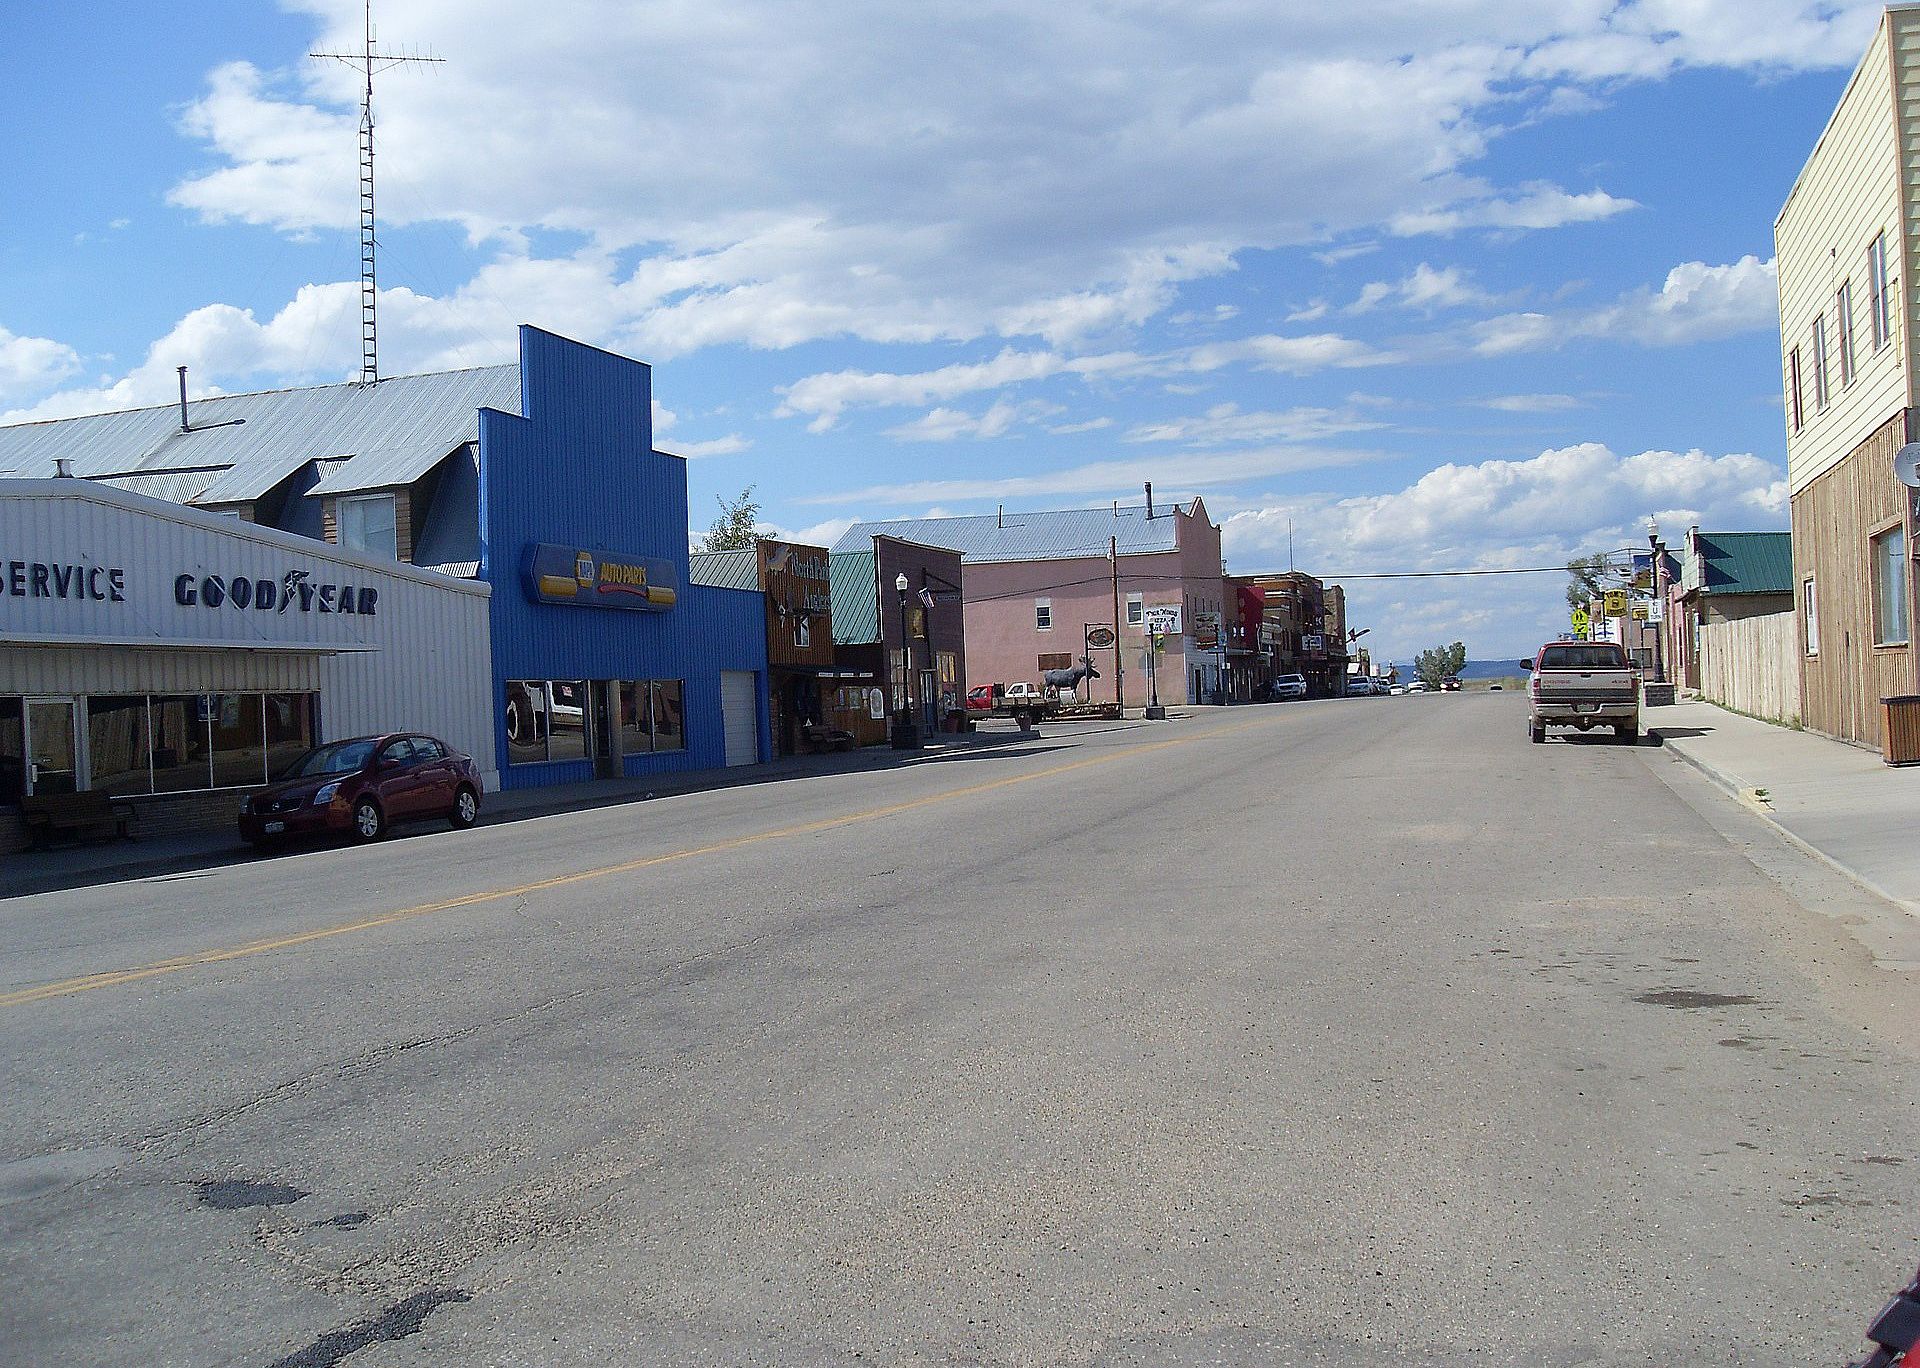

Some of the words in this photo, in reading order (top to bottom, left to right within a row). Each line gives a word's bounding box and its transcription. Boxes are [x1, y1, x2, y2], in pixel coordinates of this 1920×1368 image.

[600, 562, 622, 583] AUTO
[623, 565, 647, 586] PARTS
[174, 570, 379, 616] GOODYEAR
